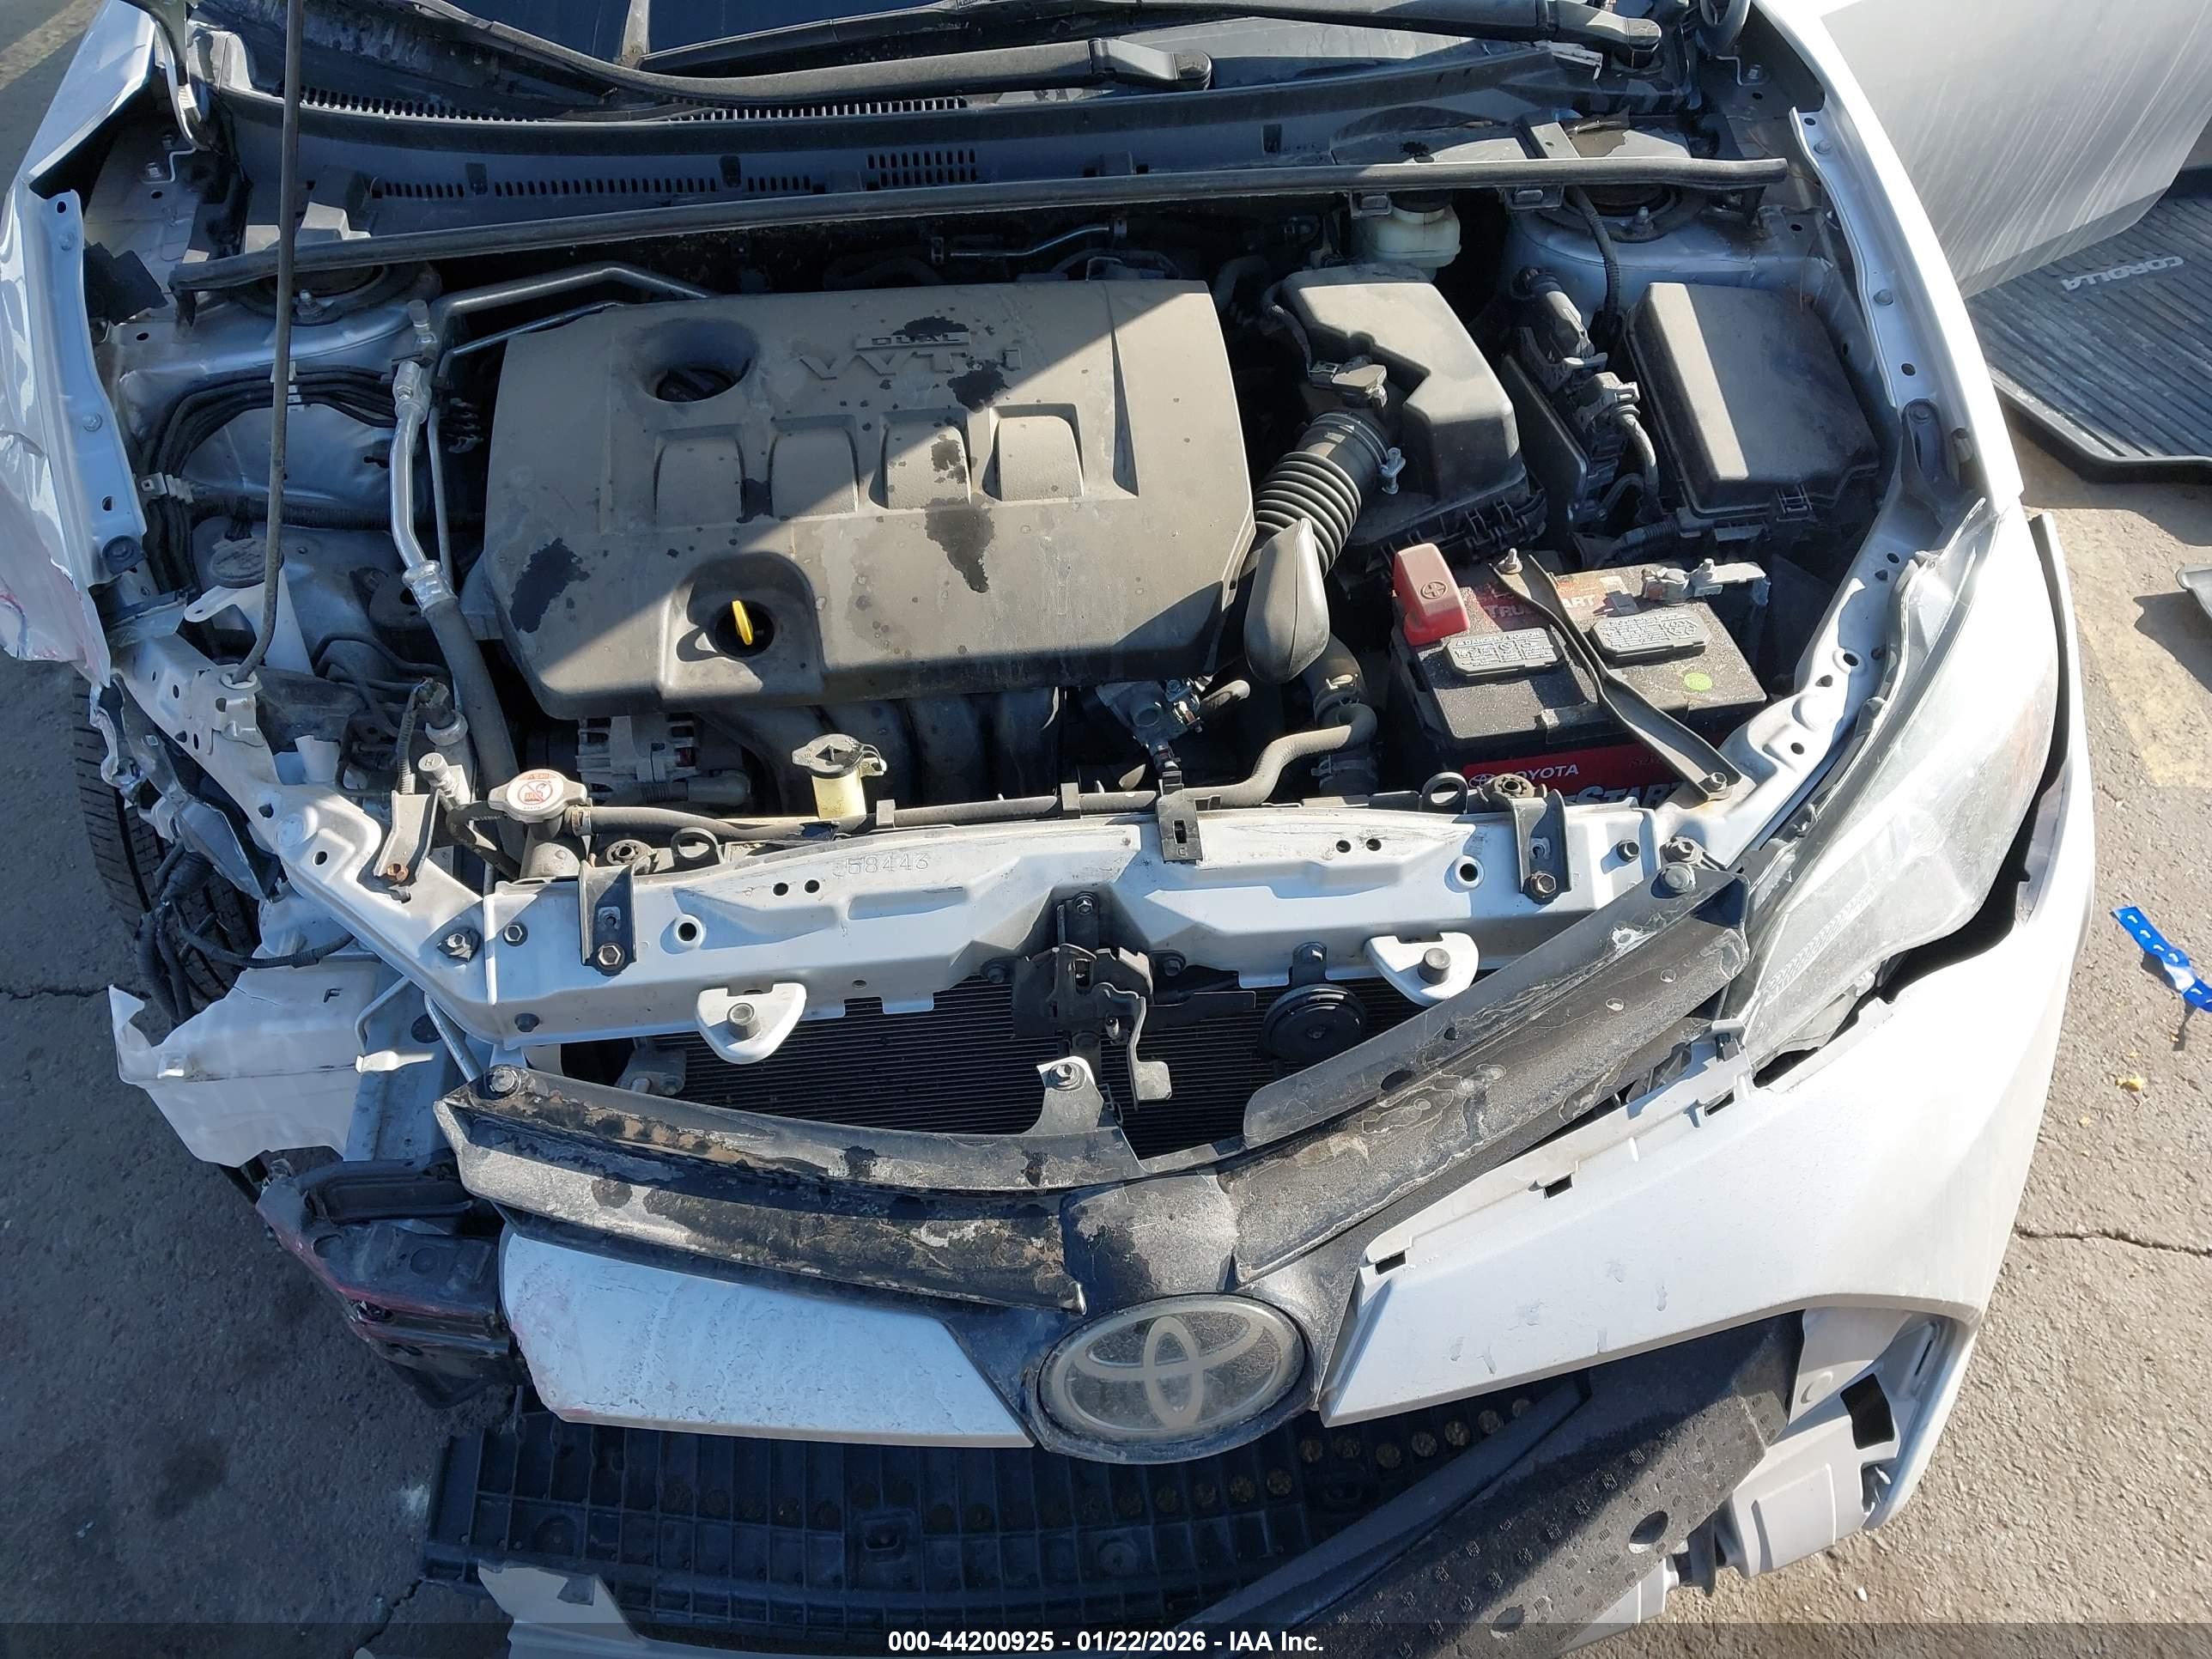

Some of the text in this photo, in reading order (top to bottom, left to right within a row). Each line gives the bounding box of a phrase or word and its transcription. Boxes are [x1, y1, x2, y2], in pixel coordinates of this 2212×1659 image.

[2062, 256, 2185, 292] COROLLA
[1515, 763, 1580, 781] OYOTA
[323, 988, 343, 1004] F
